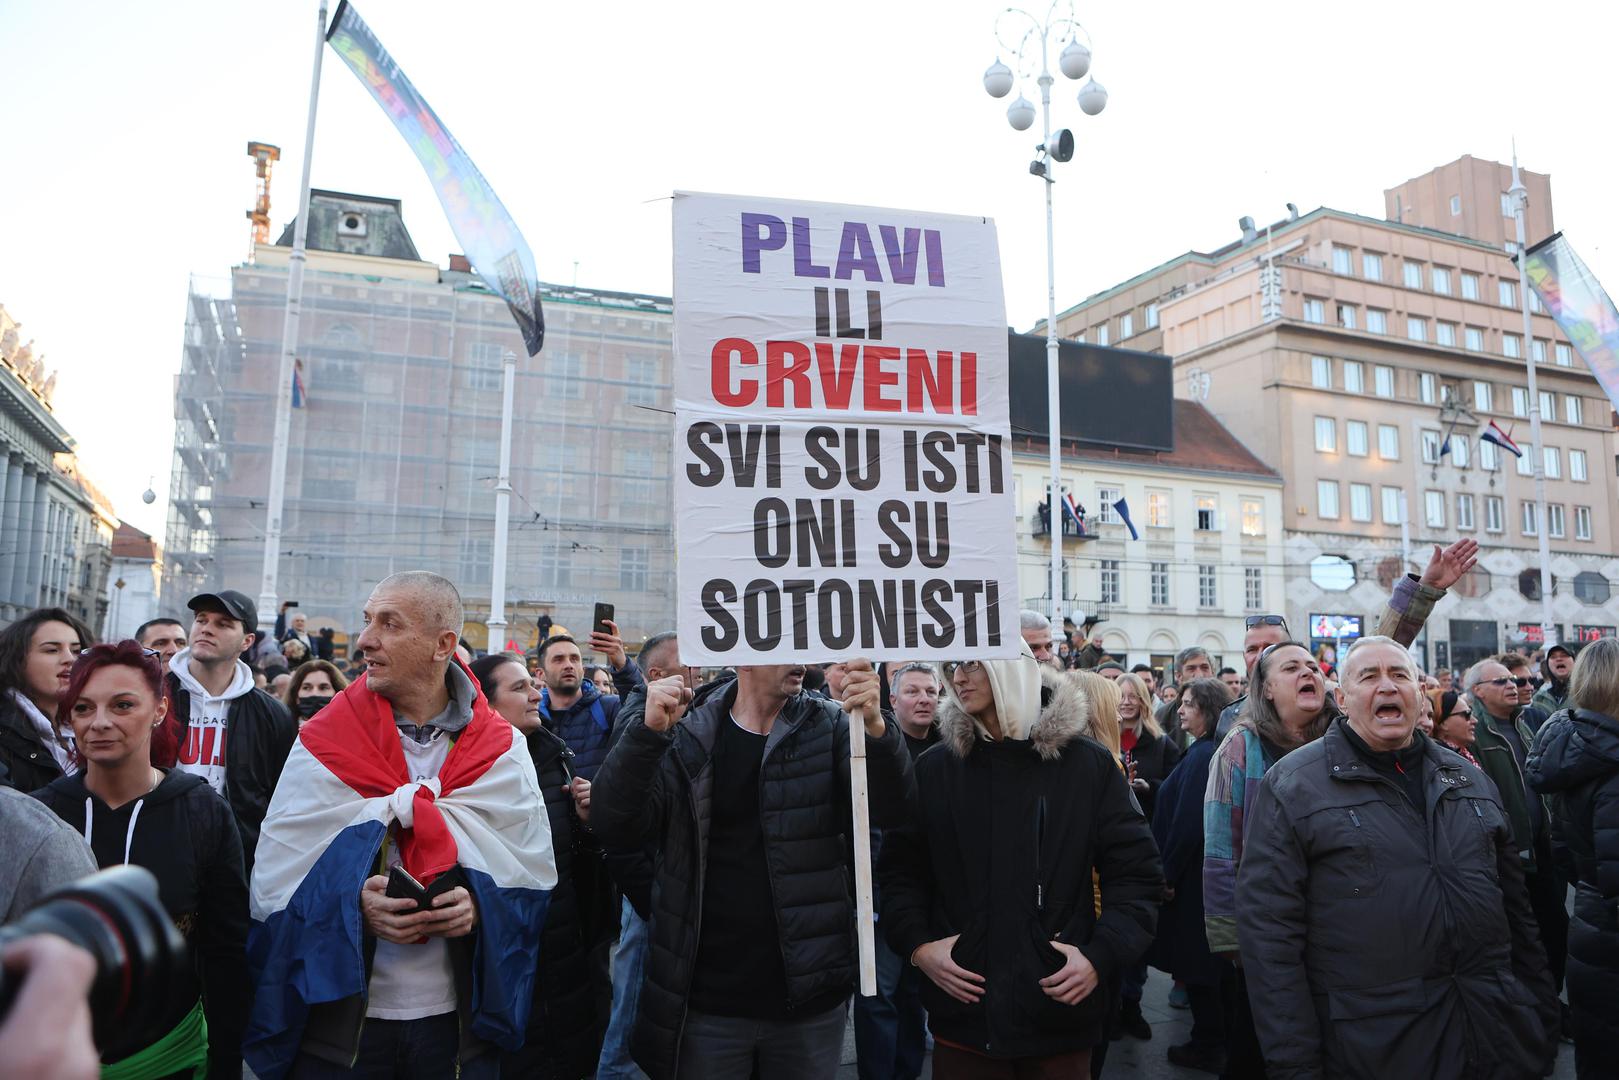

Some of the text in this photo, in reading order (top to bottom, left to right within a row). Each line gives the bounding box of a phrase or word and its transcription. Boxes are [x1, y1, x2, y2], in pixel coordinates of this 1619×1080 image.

[741, 212, 945, 287] PLAVI
[814, 286, 882, 340] ILI
[711, 337, 977, 415] CRVENI
[686, 421, 1004, 494] SVI SU ISTI
[753, 497, 950, 569] ONI SU
[700, 578, 1001, 652] SOTONISTI
